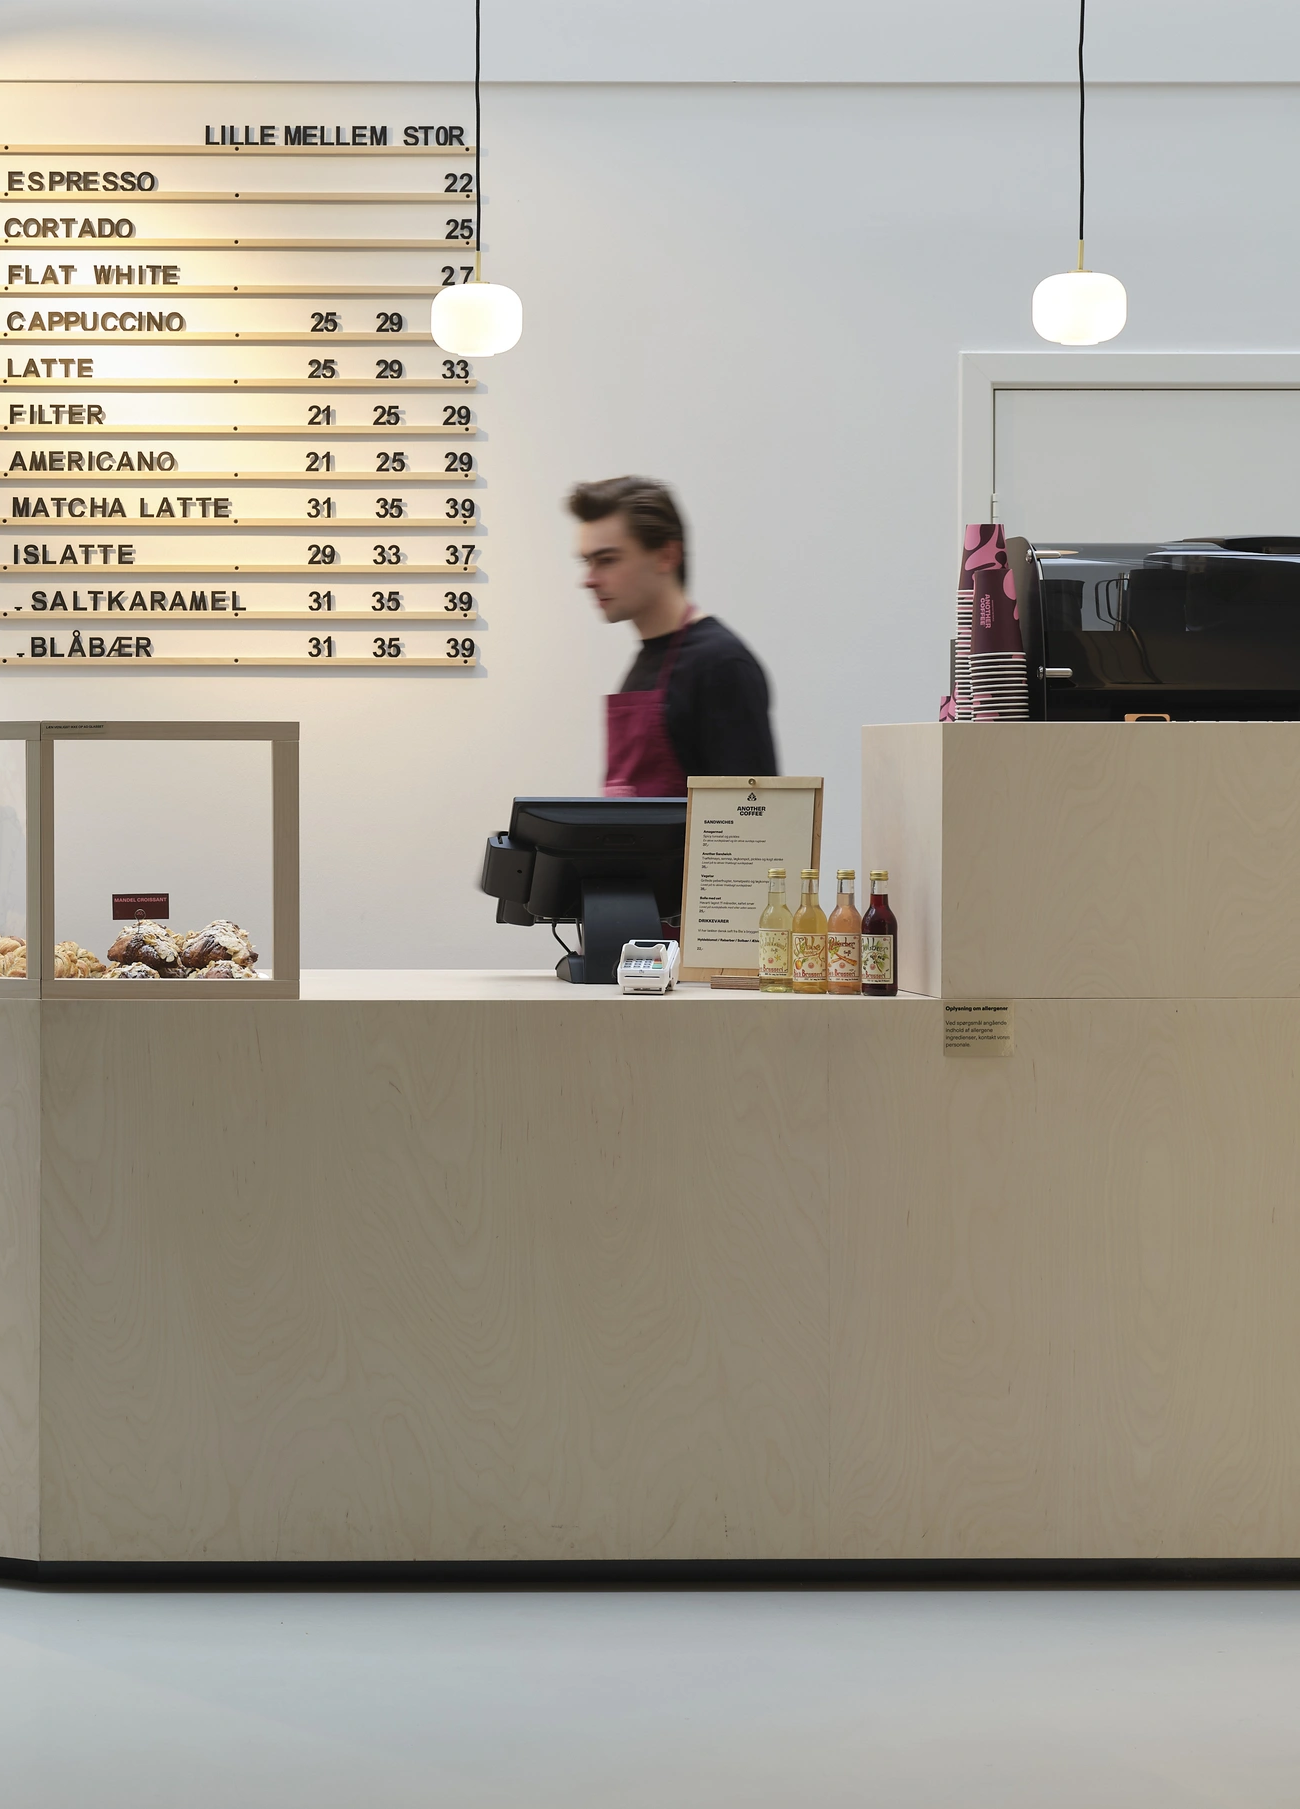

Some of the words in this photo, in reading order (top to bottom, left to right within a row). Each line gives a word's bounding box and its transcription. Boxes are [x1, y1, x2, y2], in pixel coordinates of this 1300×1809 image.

[205, 125, 275, 145] LILLE
[284, 125, 387, 146] MELLEM
[7, 171, 155, 192] ESPRESSO
[444, 173, 473, 193] 22
[4, 218, 133, 239] CORTADO
[445, 219, 473, 240] 25
[7, 265, 75, 285] FLAT
[94, 265, 178, 285] WHITE
[441, 266, 474, 286] 27
[6, 311, 184, 332] CAPPUCCINO
[310, 312, 338, 333] 25
[375, 312, 403, 333] 29
[7, 358, 93, 378] LATTE
[308, 359, 336, 379] 25
[375, 359, 403, 379] 29
[441, 360, 469, 379] 33
[9, 404, 103, 424] FILTER
[307, 405, 332, 425] 21
[372, 405, 400, 425] 25
[442, 406, 471, 426] 29
[9, 451, 175, 471] AMERICANO
[305, 452, 332, 472] 21
[375, 452, 405, 472] 25
[444, 452, 472, 472] 29
[11, 497, 126, 517] MATCHA
[139, 497, 230, 517] LATTE
[307, 498, 332, 518] 31
[375, 498, 403, 519] 35
[445, 498, 475, 519] 39
[13, 544, 134, 565] ISLATTE
[307, 544, 335, 565] 29
[372, 544, 401, 565] 33
[445, 544, 476, 565] 37
[31, 591, 246, 611] SALTKARAMEL
[308, 591, 332, 611] 31
[371, 591, 400, 612] 35
[443, 591, 472, 612] 39
[30, 629, 152, 658] BLÅBÆR
[308, 637, 332, 657] 31
[372, 637, 400, 658] 35
[446, 637, 475, 658] 39
